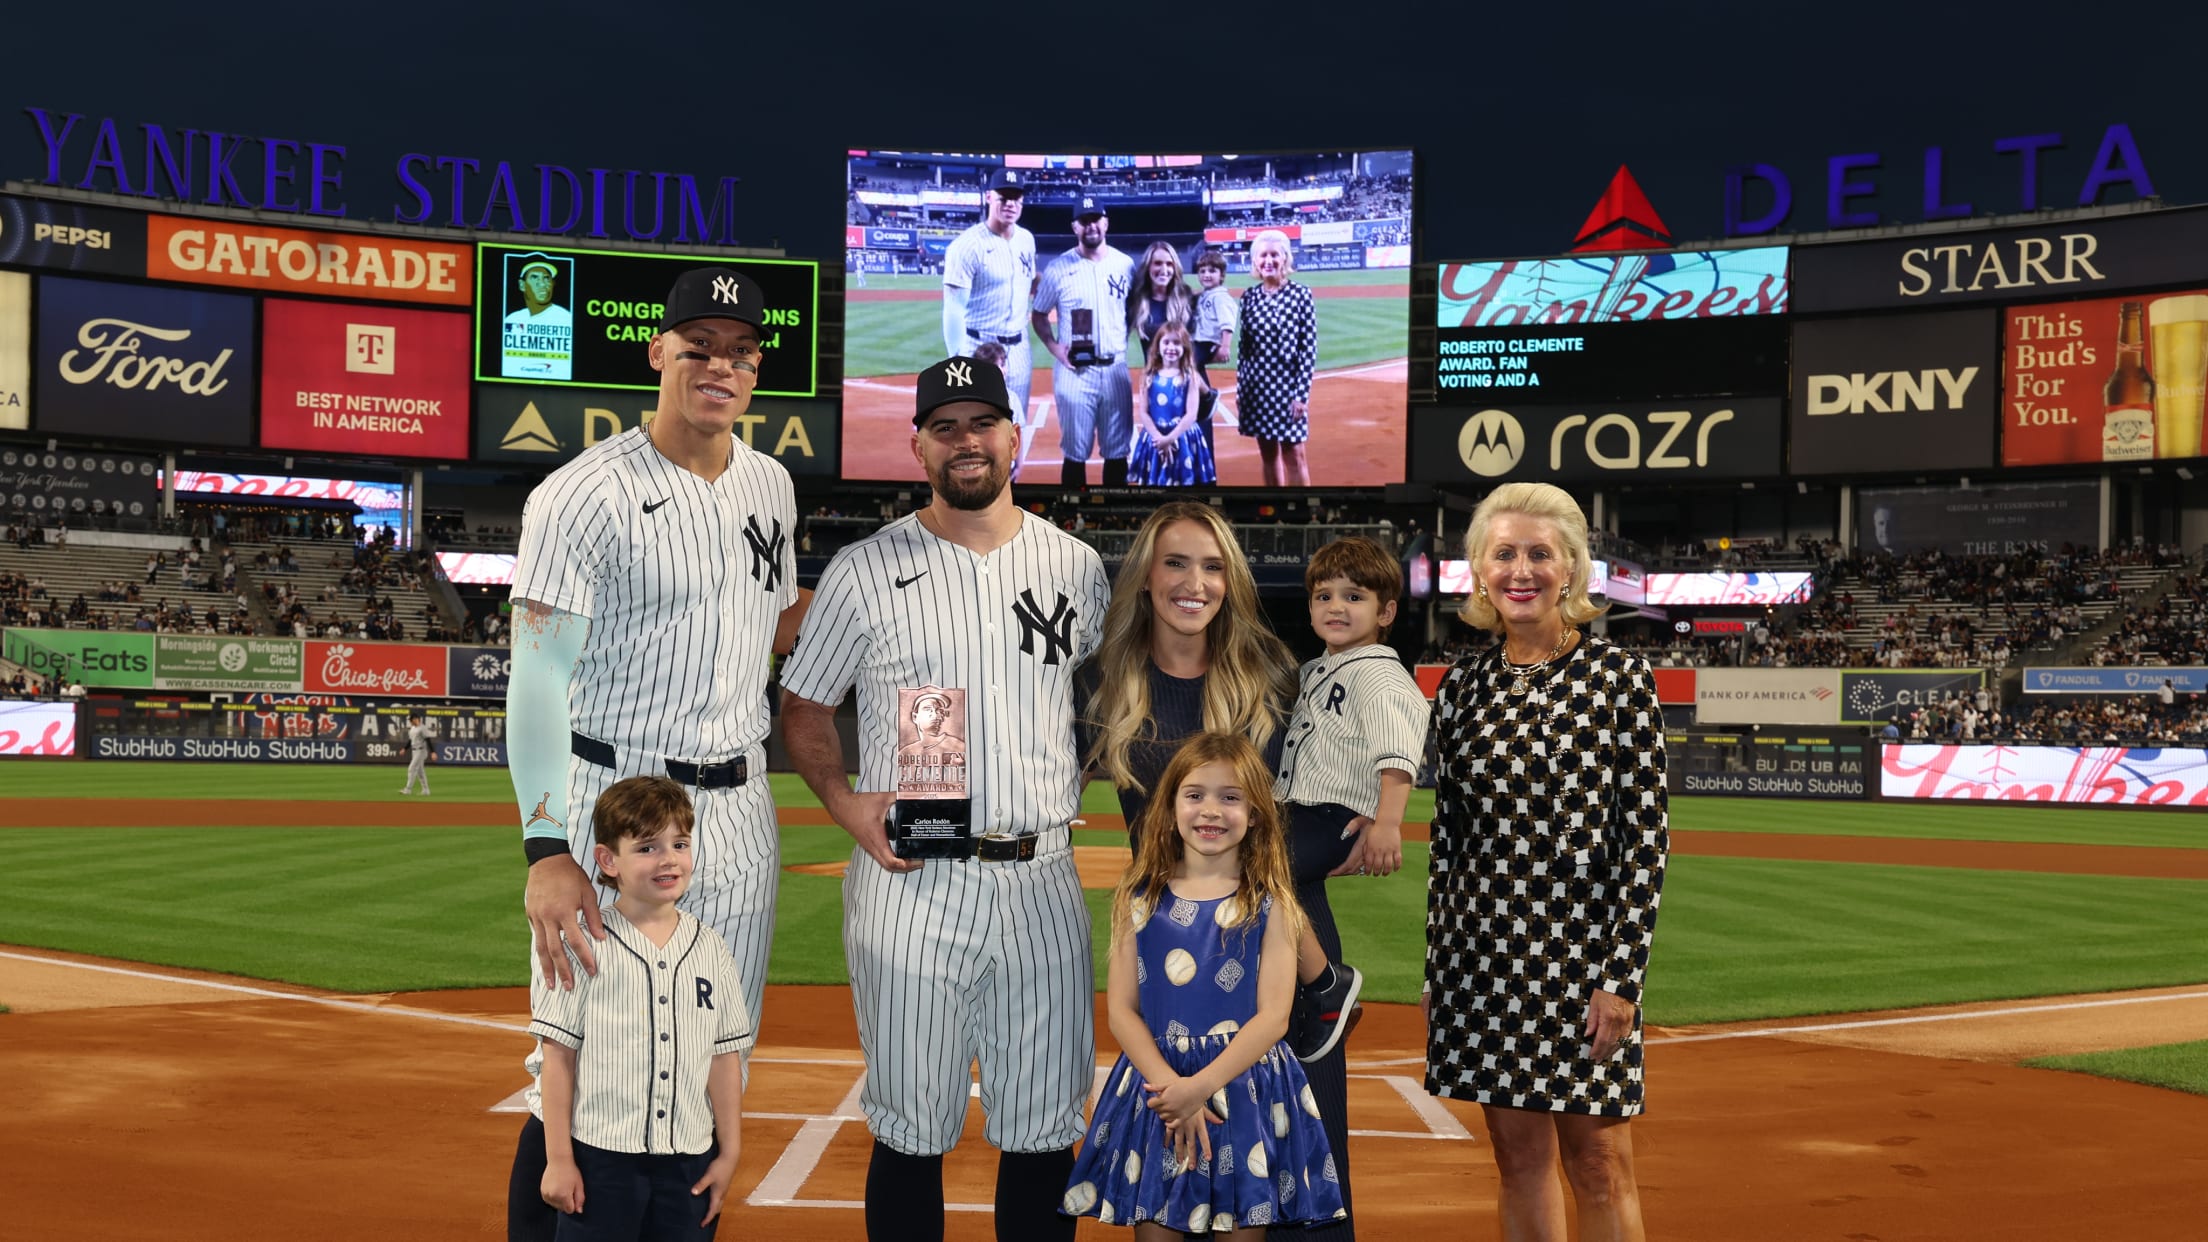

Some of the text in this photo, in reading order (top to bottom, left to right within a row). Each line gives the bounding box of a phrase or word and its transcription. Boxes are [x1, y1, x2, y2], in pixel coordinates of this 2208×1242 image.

[25, 107, 739, 246] YANKEE STADIUM
[1724, 123, 2155, 237] DELTA
[35, 223, 111, 249] PEPSI
[168, 230, 457, 293] GATORADE
[1899, 233, 2106, 297] STARR
[712, 275, 739, 305] NY
[527, 323, 571, 336] ROBERTO
[2015, 313, 2084, 340] This
[504, 334, 571, 351] CLEMENTE
[1439, 337, 1584, 355] ROBERTO CLEMENTE
[58, 317, 234, 397] Ford
[1438, 356, 1528, 371] AWARD. FAN
[945, 361, 973, 387] NY
[1438, 373, 1540, 388] VOTING AND A
[2015, 373, 2065, 398] For
[296, 391, 442, 417] BEST NETWORK
[1807, 367, 1980, 416] DKNY
[313, 411, 424, 435] IN AMERICA
[2013, 402, 2078, 427] You.
[1550, 409, 1734, 471] razr
[743, 513, 786, 591] NY
[1263, 554, 1301, 564] StubHub
[1963, 541, 1999, 556] THE
[1011, 588, 1077, 665] NY
[1695, 620, 1745, 634] TOYOTA
[10, 644, 148, 672] Uber Eats
[160, 638, 217, 654] Morningside
[248, 641, 298, 654] Workmen's
[269, 654, 297, 667] Circle
[321, 653, 429, 692] Chick-fil-A
[165, 679, 292, 690] WWW.CASSENACARE.COM
[2054, 675, 2103, 685] FANDUEL
[1325, 682, 1346, 716] R
[1700, 690, 1807, 700] BANK OF AMERICA
[99, 738, 347, 760] StubHub StubHub StubHub
[443, 746, 499, 762] STARR
[916, 783, 947, 792] AWARD
[1685, 775, 1864, 794] StubHub StubHub StubHub
[696, 976, 715, 1010] R
